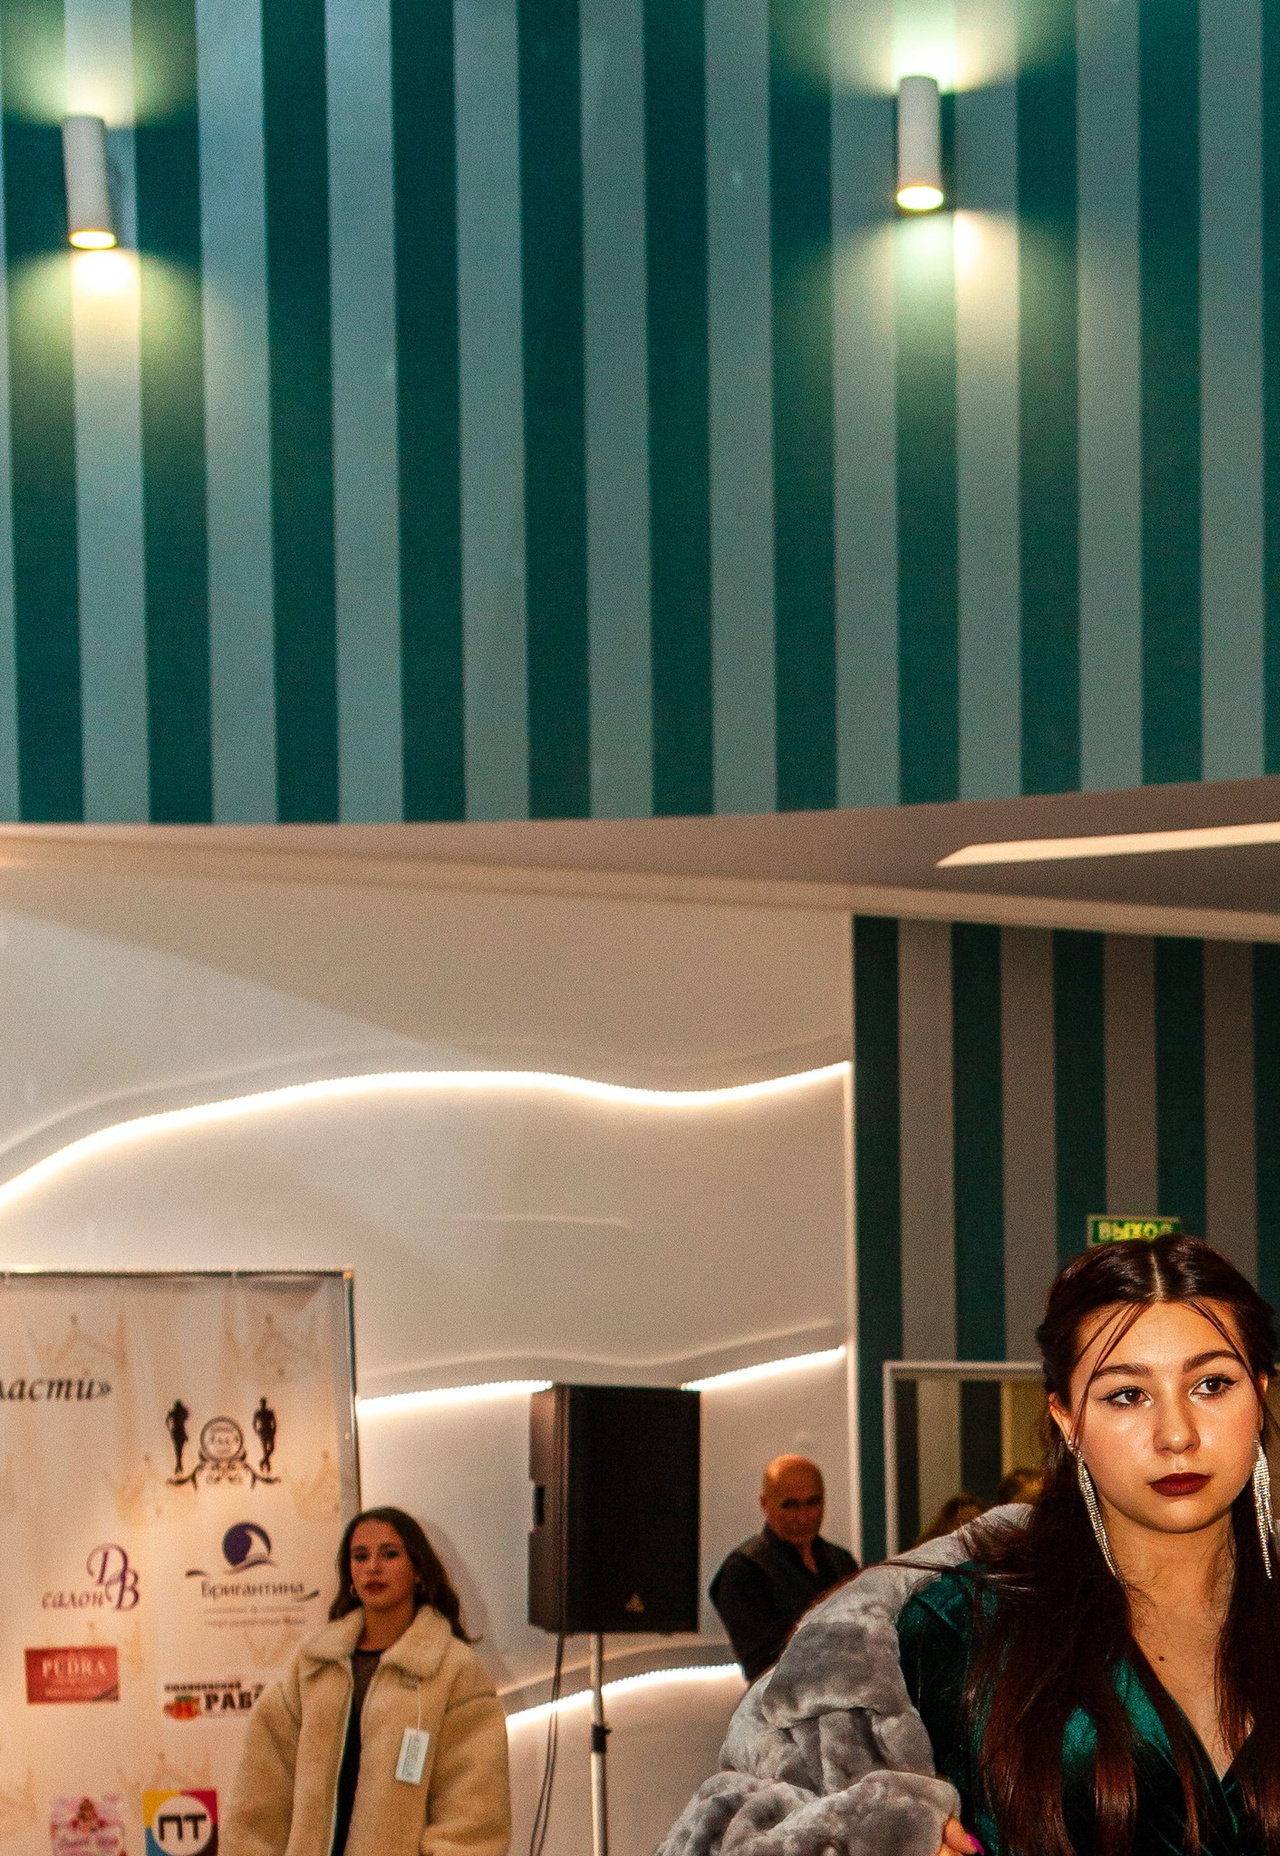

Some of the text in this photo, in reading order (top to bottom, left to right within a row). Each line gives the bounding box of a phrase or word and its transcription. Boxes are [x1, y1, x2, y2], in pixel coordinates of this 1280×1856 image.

[201, 1581, 304, 1600] Бригантина
[42, 1591, 104, 1610] салон
[158, 1813, 206, 1842] ПТ
